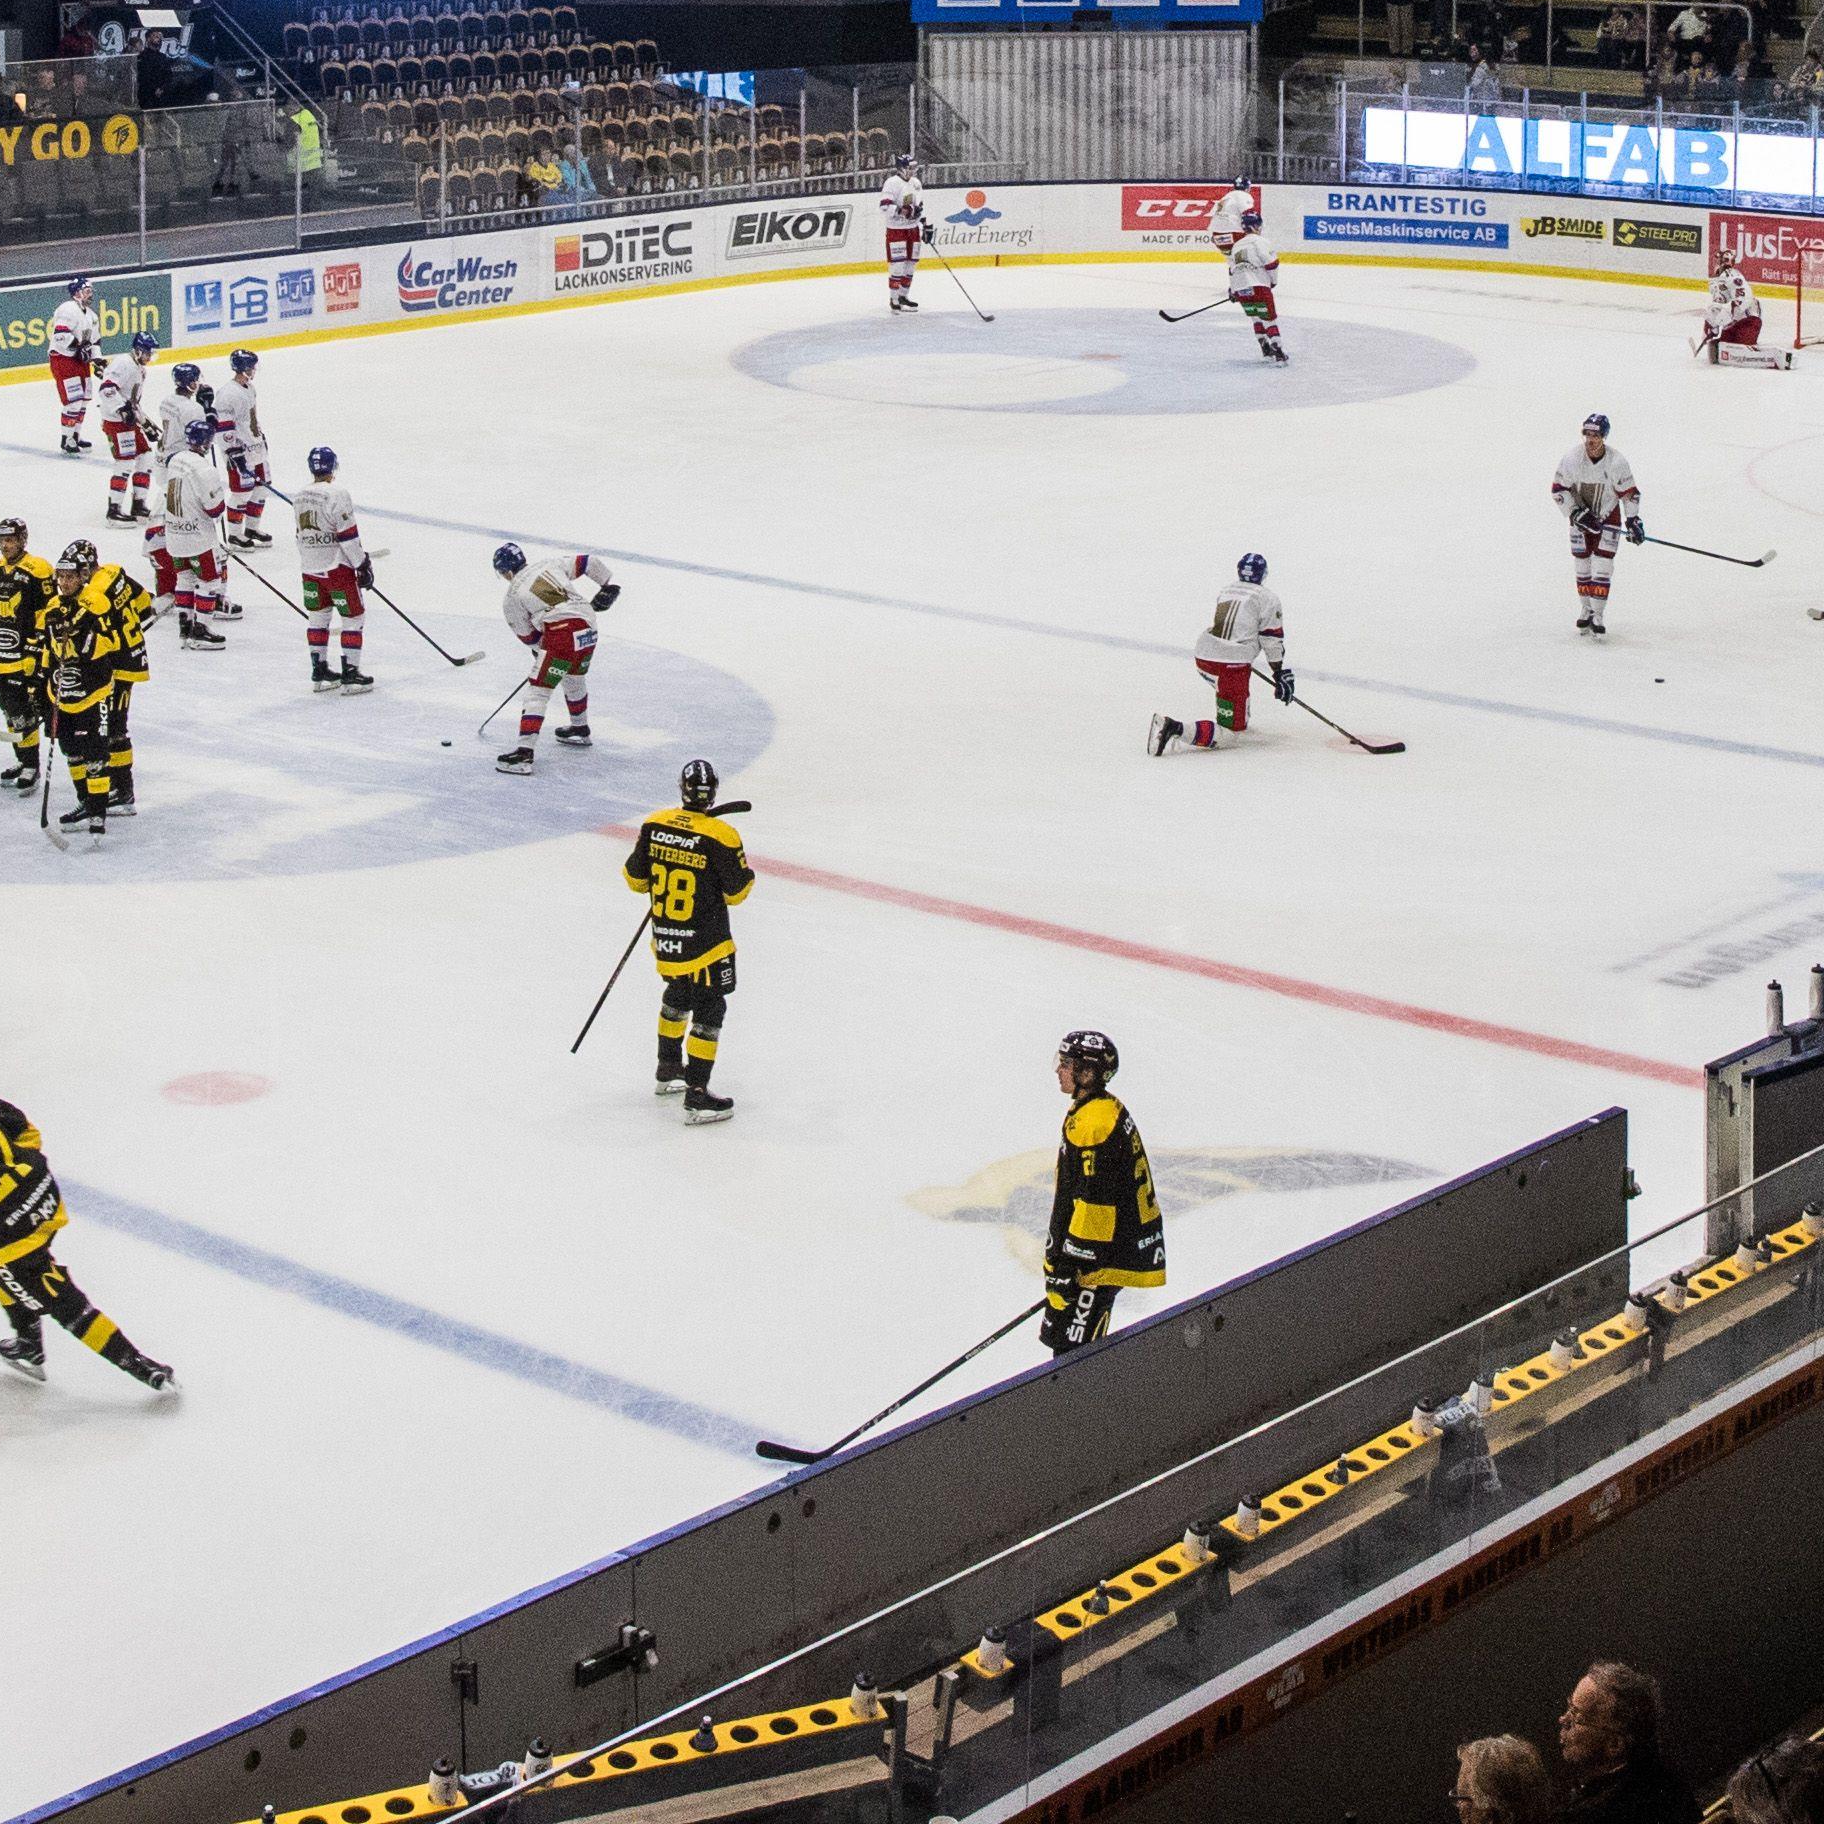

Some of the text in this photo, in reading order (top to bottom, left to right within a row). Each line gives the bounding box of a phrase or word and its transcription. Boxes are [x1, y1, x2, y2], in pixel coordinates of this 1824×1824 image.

[32, 121, 90, 161] GO
[1466, 115, 1728, 187] ALFAB
[1328, 192, 1487, 217] BRANTESTIG
[1142, 235, 1191, 245] MADE OF
[1316, 220, 1497, 242] SvetsMaskinservice AB
[1525, 216, 1604, 238] JB SMIDE
[1638, 224, 1697, 244] STEELPRO
[415, 256, 518, 288] CarWash
[554, 260, 694, 292] LACKKONSERVERING
[437, 282, 514, 309] Center
[651, 831, 696, 850] LOOPIA
[651, 862, 696, 921] 28
[1634, 1425, 1726, 1498] WESTERÅS
[1732, 1373, 1817, 1441] MARKISER
[1320, 1512, 1574, 1678] WESTERÅS MARKISER AB
